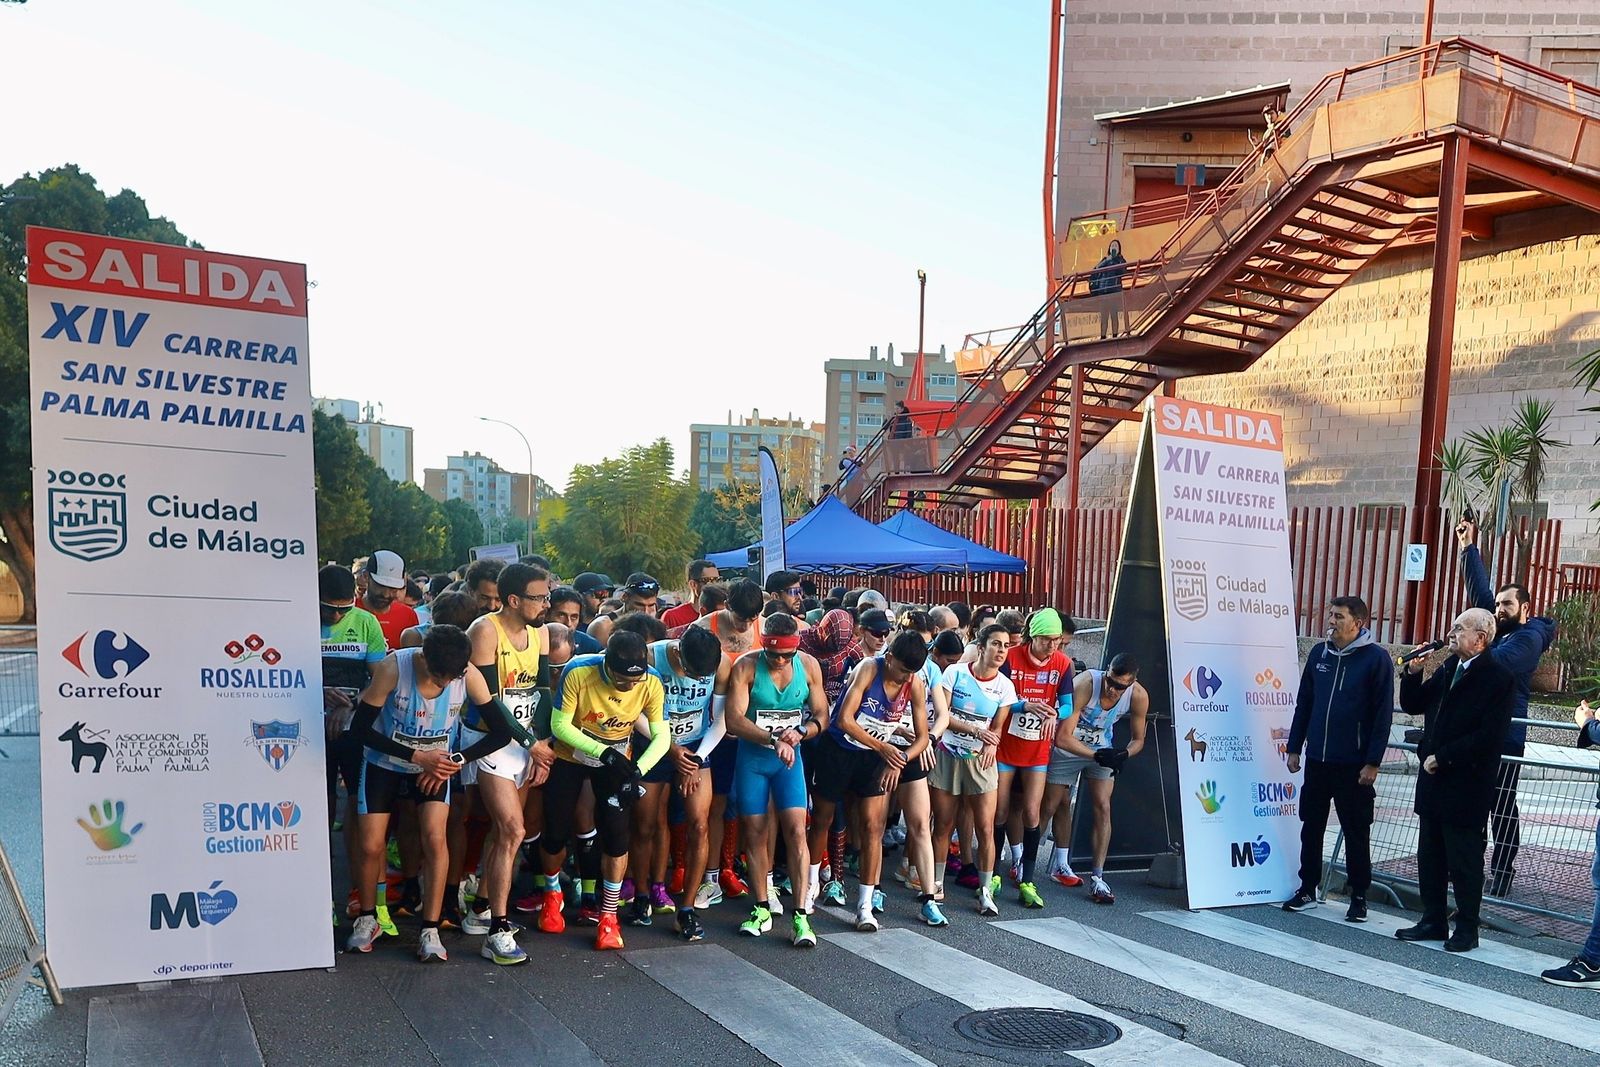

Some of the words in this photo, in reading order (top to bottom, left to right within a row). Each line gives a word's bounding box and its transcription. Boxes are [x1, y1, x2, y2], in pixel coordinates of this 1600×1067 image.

[42, 241, 295, 308] SALIDA
[42, 301, 150, 348] XIV
[163, 333, 299, 365] CARRERA
[61, 360, 126, 386] SAN
[135, 367, 287, 400] SILVESTRE
[40, 391, 151, 421] PALMA
[161, 401, 306, 434] PALMILLA
[1162, 403, 1276, 446] SALIDA
[1163, 445, 1211, 476] XIV
[1217, 464, 1280, 485] CARRERA
[1173, 484, 1202, 501] SAN
[1206, 489, 1275, 510] SILVESTRE
[147, 494, 258, 522] Ciudad
[1165, 506, 1214, 525] PALMA
[1218, 512, 1285, 533] PALMILLA
[148, 528, 188, 550] de
[198, 528, 305, 560] Málaga
[1216, 575, 1267, 594] Ciudad
[1217, 598, 1236, 612] de
[1240, 599, 1289, 619] Málaga
[201, 668, 307, 688] ROSALEDA
[58, 682, 162, 698] Carrefour
[1246, 691, 1294, 706] ROSALEDA
[513, 702, 536, 720] 616
[1182, 701, 1229, 712] Carrefour
[1018, 716, 1042, 731] 922
[193, 733, 208, 742] DE
[116, 749, 124, 757] A
[129, 749, 143, 757] LA
[148, 749, 209, 757] COMUNIDAD
[116, 765, 150, 773] PALMA
[164, 764, 210, 772] PALMILLA
[1258, 782, 1283, 802] BCM
[203, 802, 217, 833] GRUPO
[219, 802, 271, 832] BCM
[1253, 803, 1297, 817] GestionARTE
[206, 833, 298, 854] GestionARTE
[180, 962, 234, 973] deporinter
